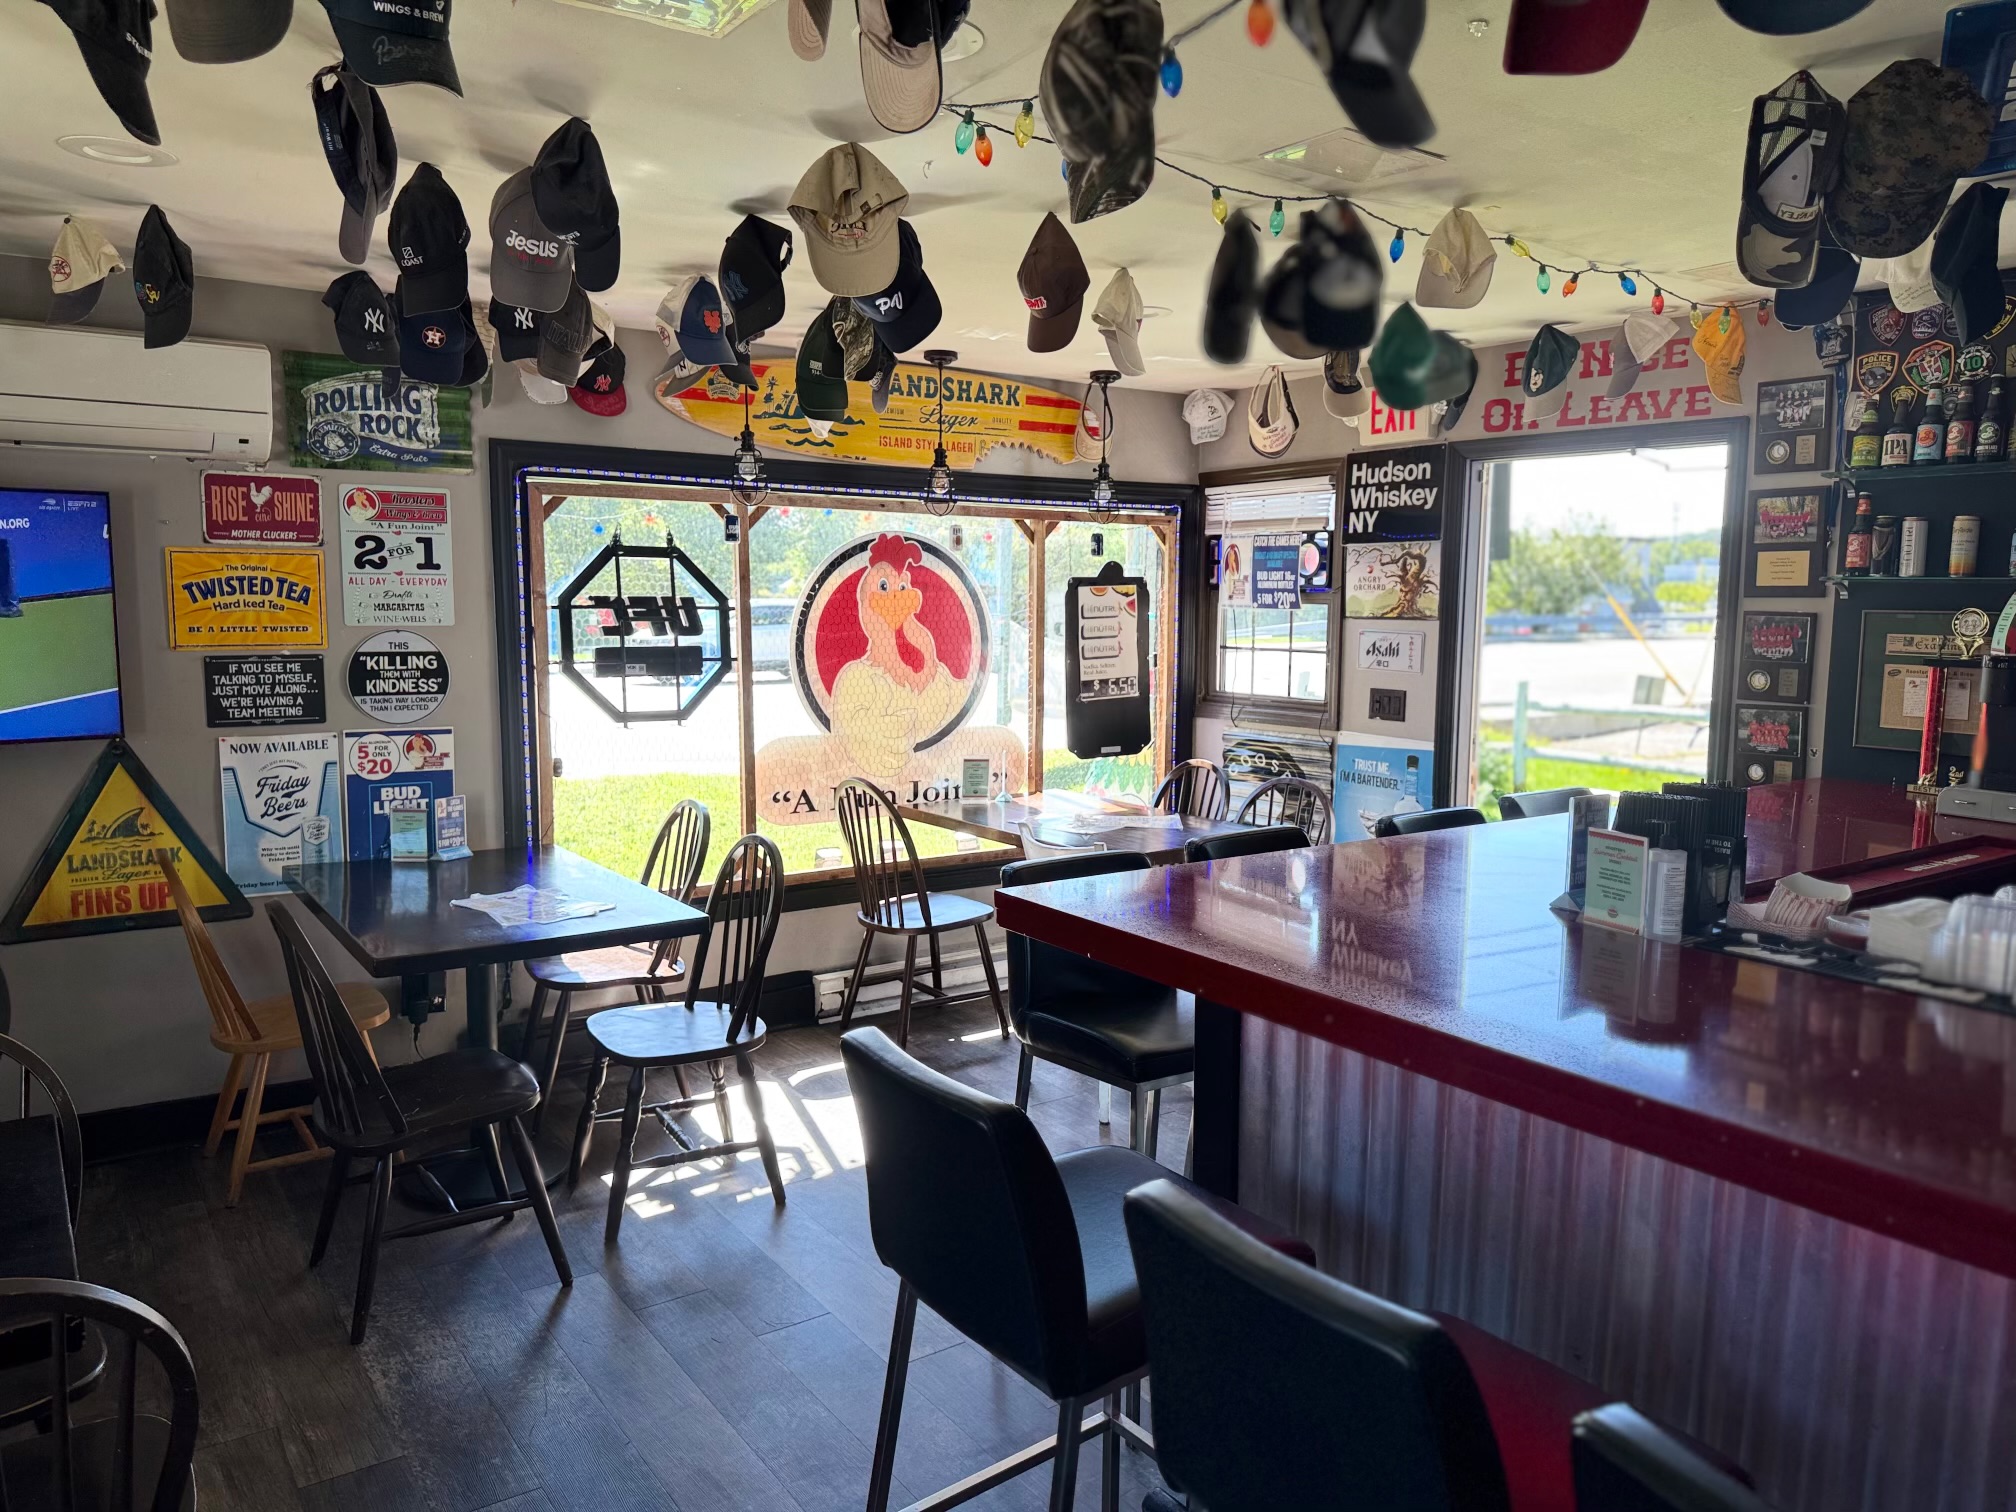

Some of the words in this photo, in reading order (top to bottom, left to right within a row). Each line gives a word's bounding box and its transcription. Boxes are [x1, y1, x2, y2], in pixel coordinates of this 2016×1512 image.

[373, 1, 412, 16] WINGS
[414, 9, 421, 17] &
[422, 11, 444, 23] BREW
[506, 230, 559, 258] Jesus
[364, 308, 384, 333] NY
[514, 308, 534, 329] NY
[1862, 355, 1892, 363] POLICE
[888, 373, 1021, 407] ANDSHARK
[314, 383, 422, 416] ROLLING
[1556, 386, 1712, 427] LEAVE
[919, 403, 979, 433] Lager
[314, 424, 348, 441] PREMIUM
[359, 413, 423, 443] ROCK
[369, 443, 398, 459] Extra
[879, 436, 912, 449] ISLAND
[915, 438, 935, 450] STYL
[945, 441, 973, 453] LAGER
[1884, 438, 1908, 456] IPA
[1352, 460, 1431, 486] Hudson
[391, 494, 435, 505] Roosters
[1350, 484, 1438, 510] Whiskey
[210, 485, 248, 525] RISE
[255, 507, 272, 522] and
[274, 491, 315, 525] SHINE
[385, 510, 411, 519] Wings
[413, 510, 420, 518] &
[1348, 511, 1379, 534] NY
[231, 530, 260, 538] MOTHER
[263, 531, 298, 539] CLUCKERS
[354, 535, 388, 570] 2
[387, 546, 415, 557] FOR
[415, 537, 441, 570] 1
[240, 564, 268, 572] Original
[1257, 571, 1268, 580] BUD
[1269, 571, 1284, 580] LIGHT
[349, 577, 365, 585] ALL
[400, 578, 447, 586] EVERYDAY
[182, 576, 274, 604] TWISTED
[276, 576, 311, 606] TEA
[383, 590, 412, 599] Drafts
[213, 599, 240, 612] Hard
[244, 599, 265, 608] Iced
[268, 601, 285, 611] Tea
[1257, 594, 1261, 604] 5
[1262, 594, 1272, 604] FOR
[374, 603, 425, 611] MARGARITAS
[388, 642, 409, 650] THIS
[1366, 640, 1400, 658] Asahi
[1915, 641, 1965, 650] Exaine
[229, 664, 238, 673] IF
[241, 664, 260, 673] YOU
[264, 664, 284, 672] SEE
[286, 663, 301, 672] ME
[360, 655, 438, 670] “KILLING
[213, 675, 256, 684] TALKING
[259, 675, 272, 683] TO
[276, 674, 316, 683] MYSELF,
[380, 670, 400, 678] THEM
[402, 670, 420, 678] WITH
[212, 686, 239, 695] JUST
[242, 685, 271, 695] MOVE
[274, 684, 318, 694] ALONG...
[366, 678, 442, 693] KINDNESS”
[1094, 679, 1100, 690] $
[1108, 676, 1136, 695] 6.50
[220, 697, 253, 707] WE'RE
[256, 696, 294, 706] HAVING
[296, 696, 304, 704] A
[227, 708, 256, 718] TEAM
[259, 707, 302, 716] MEETING
[230, 743, 261, 754] NOW
[264, 740, 328, 753] AVAILABLE
[358, 746, 369, 759] 5
[358, 759, 392, 774] $20
[1354, 758, 1377, 773] TRUST
[1949, 766, 1964, 777] 2nd
[1340, 769, 1350, 782] I'M
[1351, 775, 1356, 783] A
[255, 775, 311, 799] Friday
[381, 786, 421, 800] BUD
[261, 797, 308, 819] Beers
[373, 799, 429, 815] LIGHT
[772, 788, 819, 814] “A
[67, 847, 182, 873] LANDSHAK
[102, 868, 151, 882] Lager
[70, 885, 132, 918] FINS
[138, 882, 173, 910] UP
